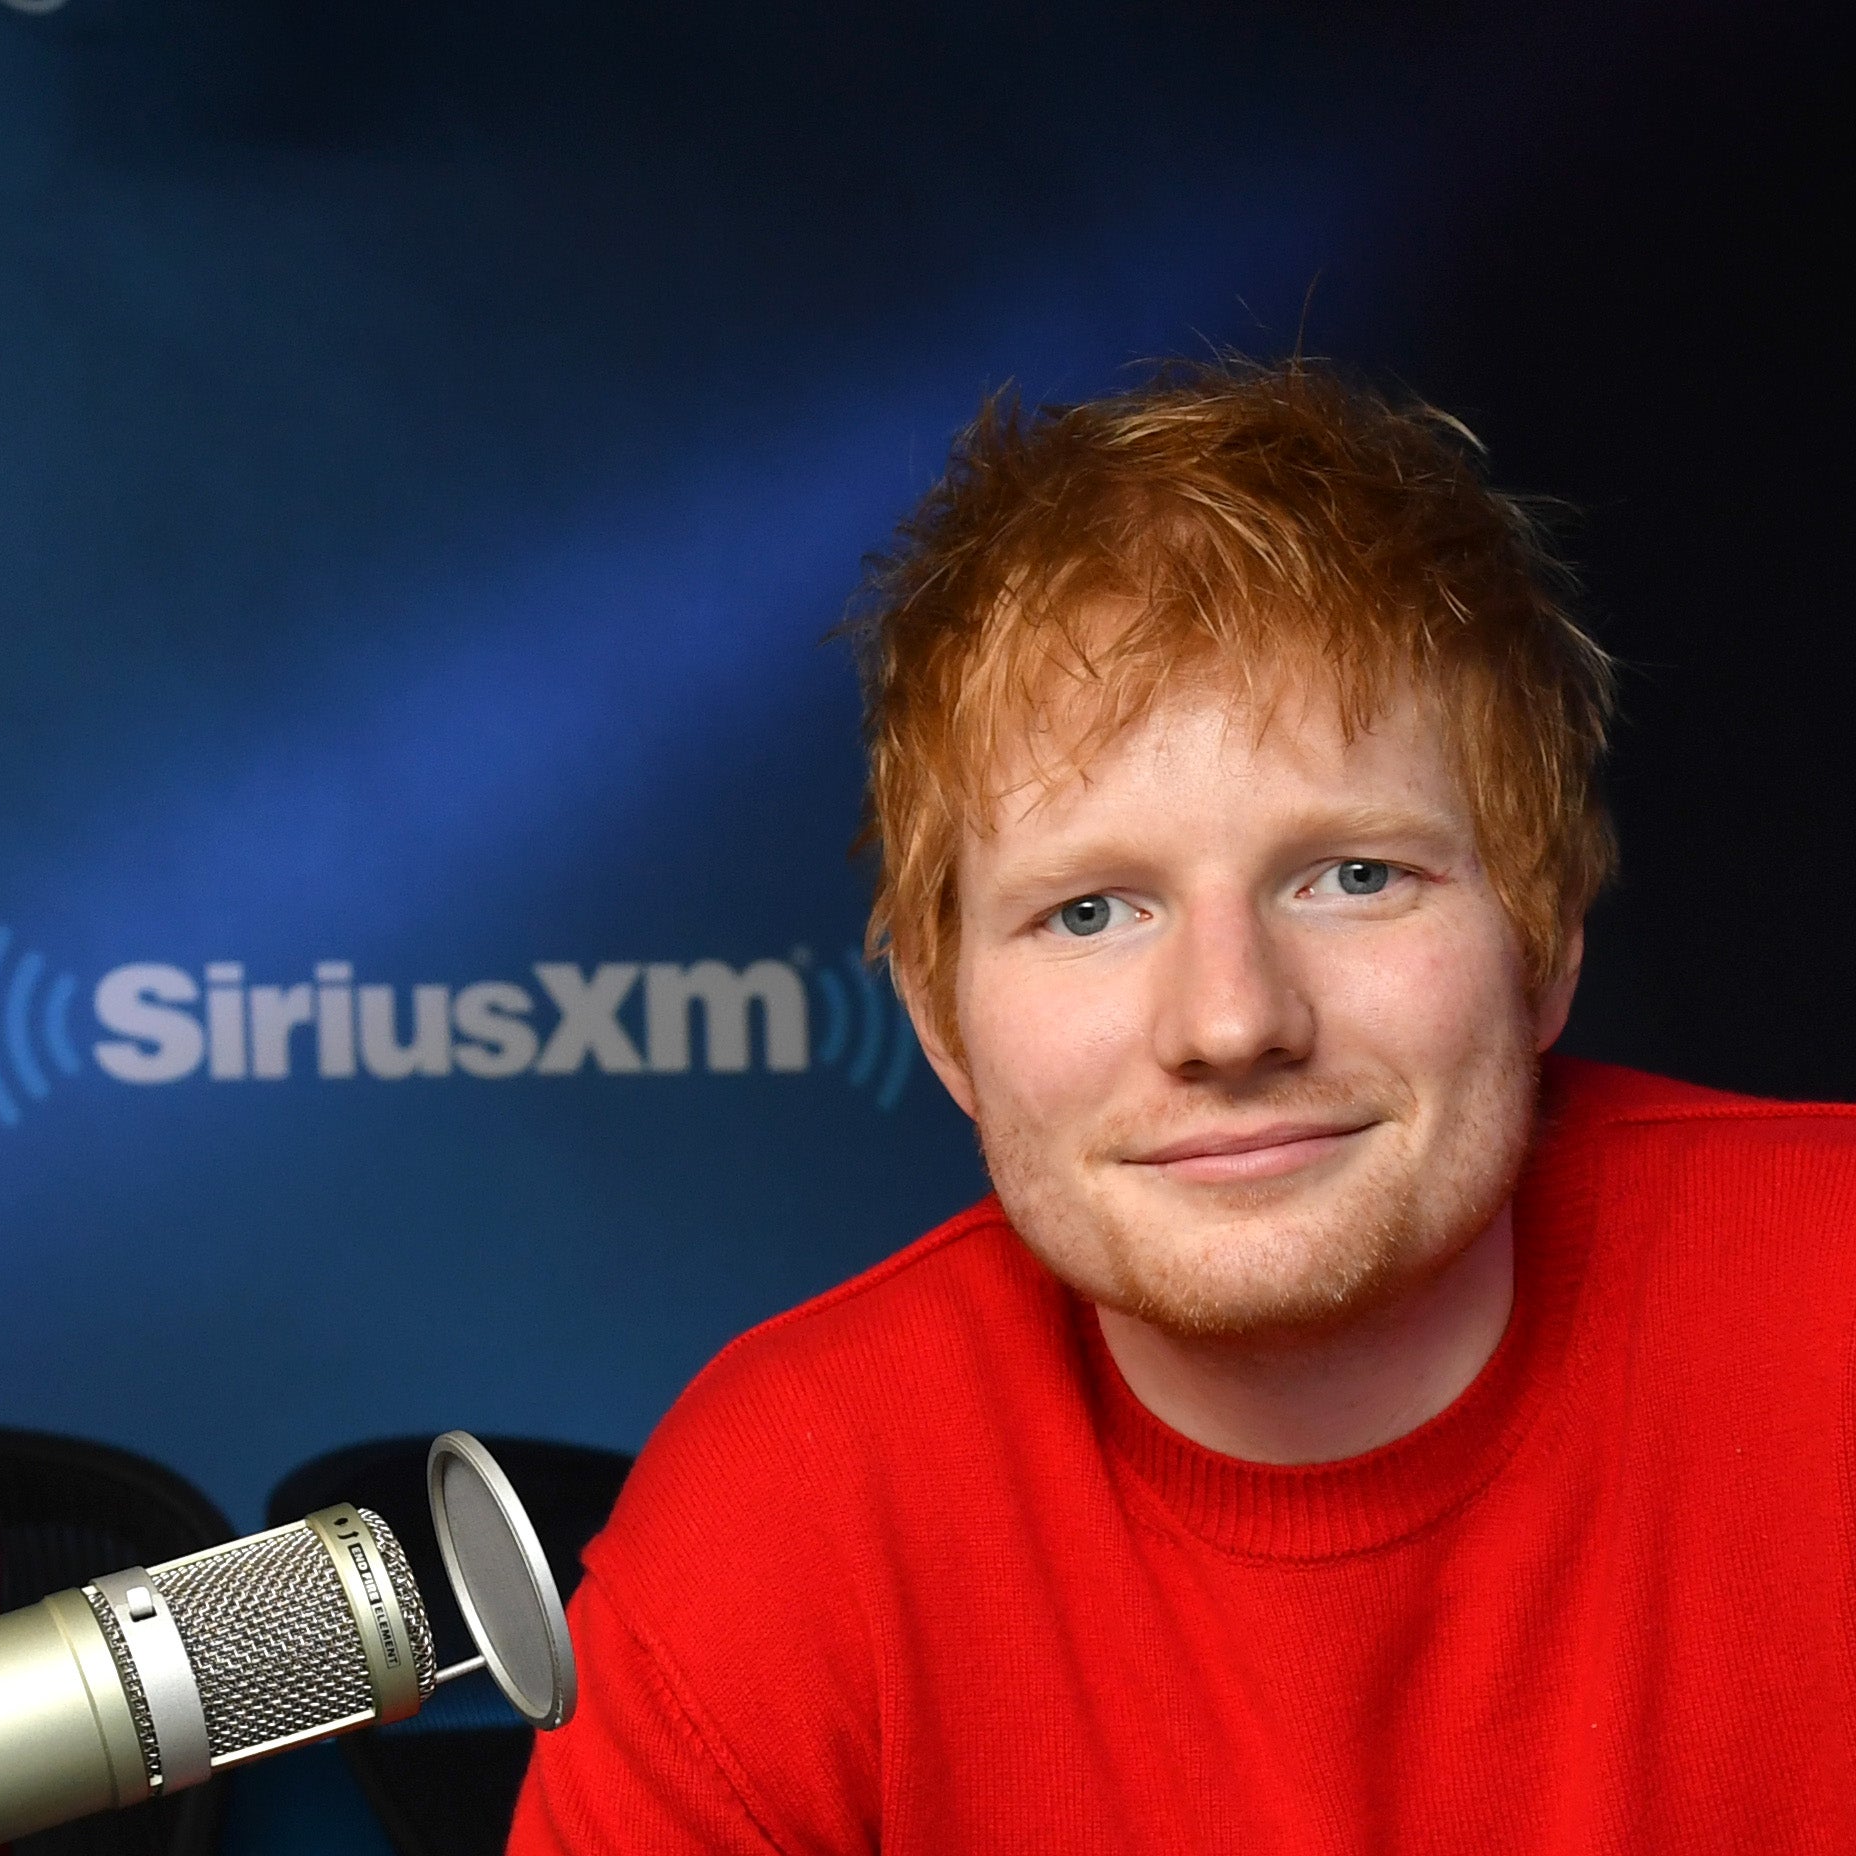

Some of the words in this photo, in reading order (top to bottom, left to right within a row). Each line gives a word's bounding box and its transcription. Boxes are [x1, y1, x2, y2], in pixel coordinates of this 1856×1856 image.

[352, 1546, 368, 1570] END
[362, 1572, 379, 1600] FIRE
[375, 1607, 397, 1663] ELEMENT
